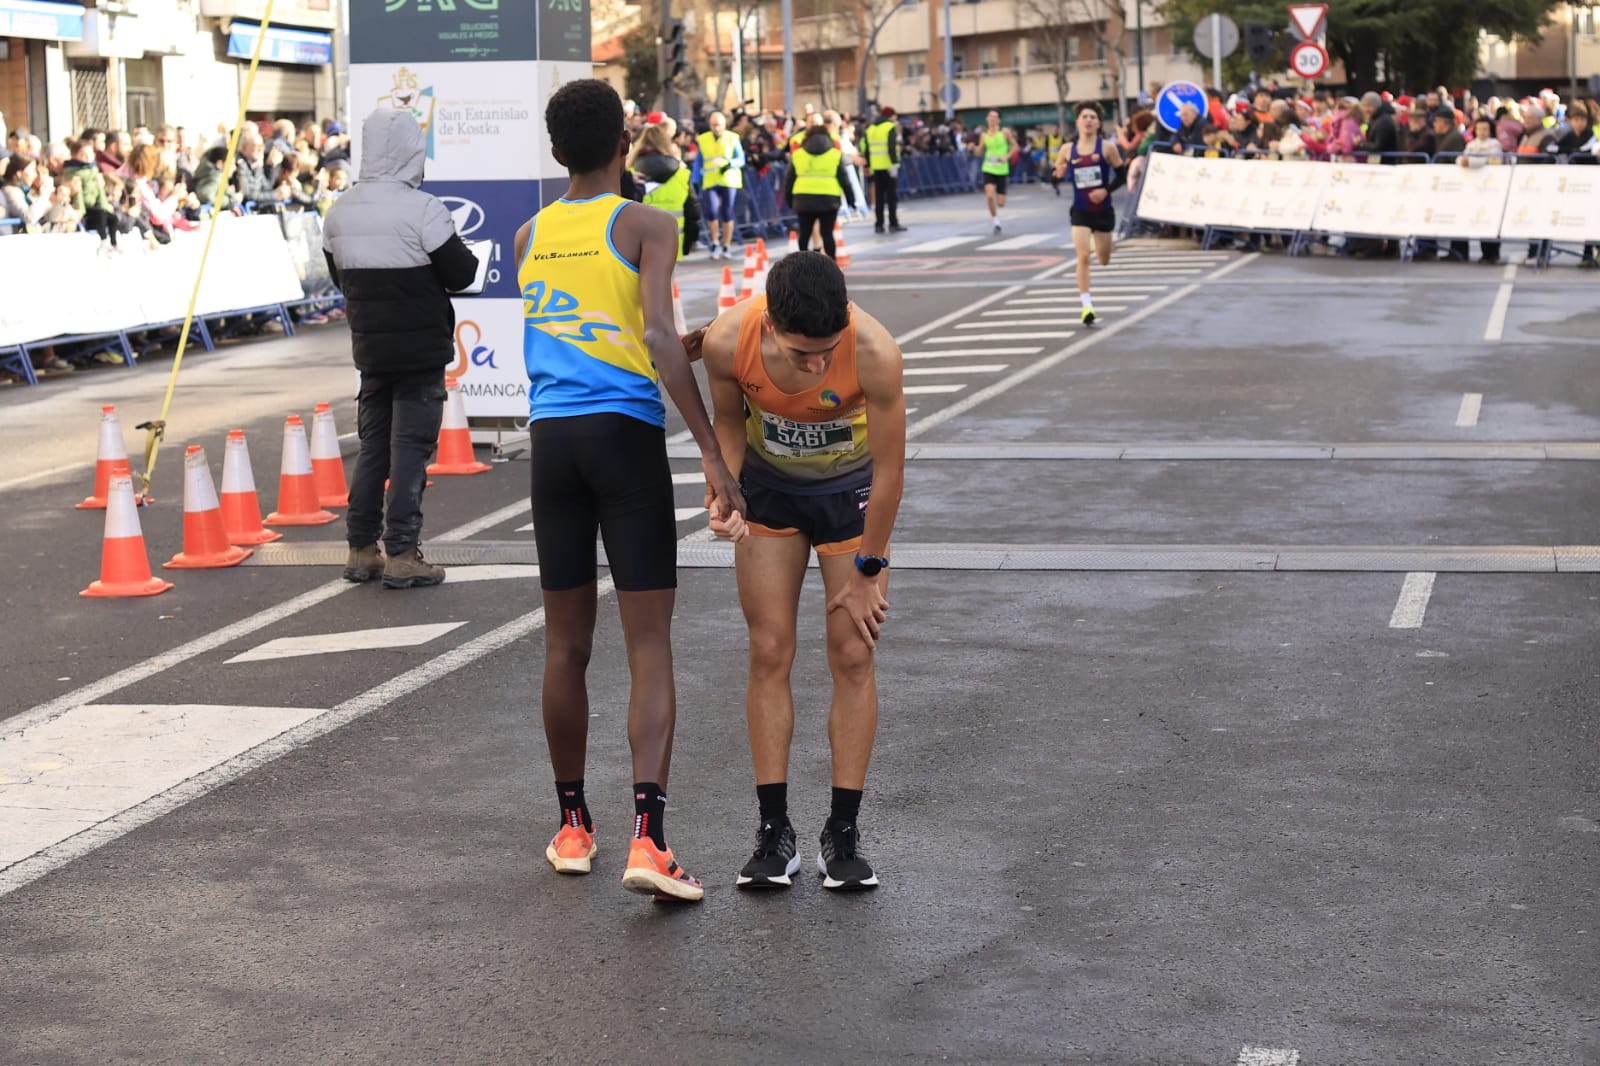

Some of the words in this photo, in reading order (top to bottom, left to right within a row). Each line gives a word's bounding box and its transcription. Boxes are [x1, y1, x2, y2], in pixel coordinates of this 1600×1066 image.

[1299, 54, 1320, 66] 30
[438, 107, 461, 121] San
[465, 106, 529, 121] Estanislao
[438, 122, 455, 136] de
[458, 121, 500, 136] Kostka
[460, 383, 527, 397] AMANCA
[777, 426, 828, 447] 5461
